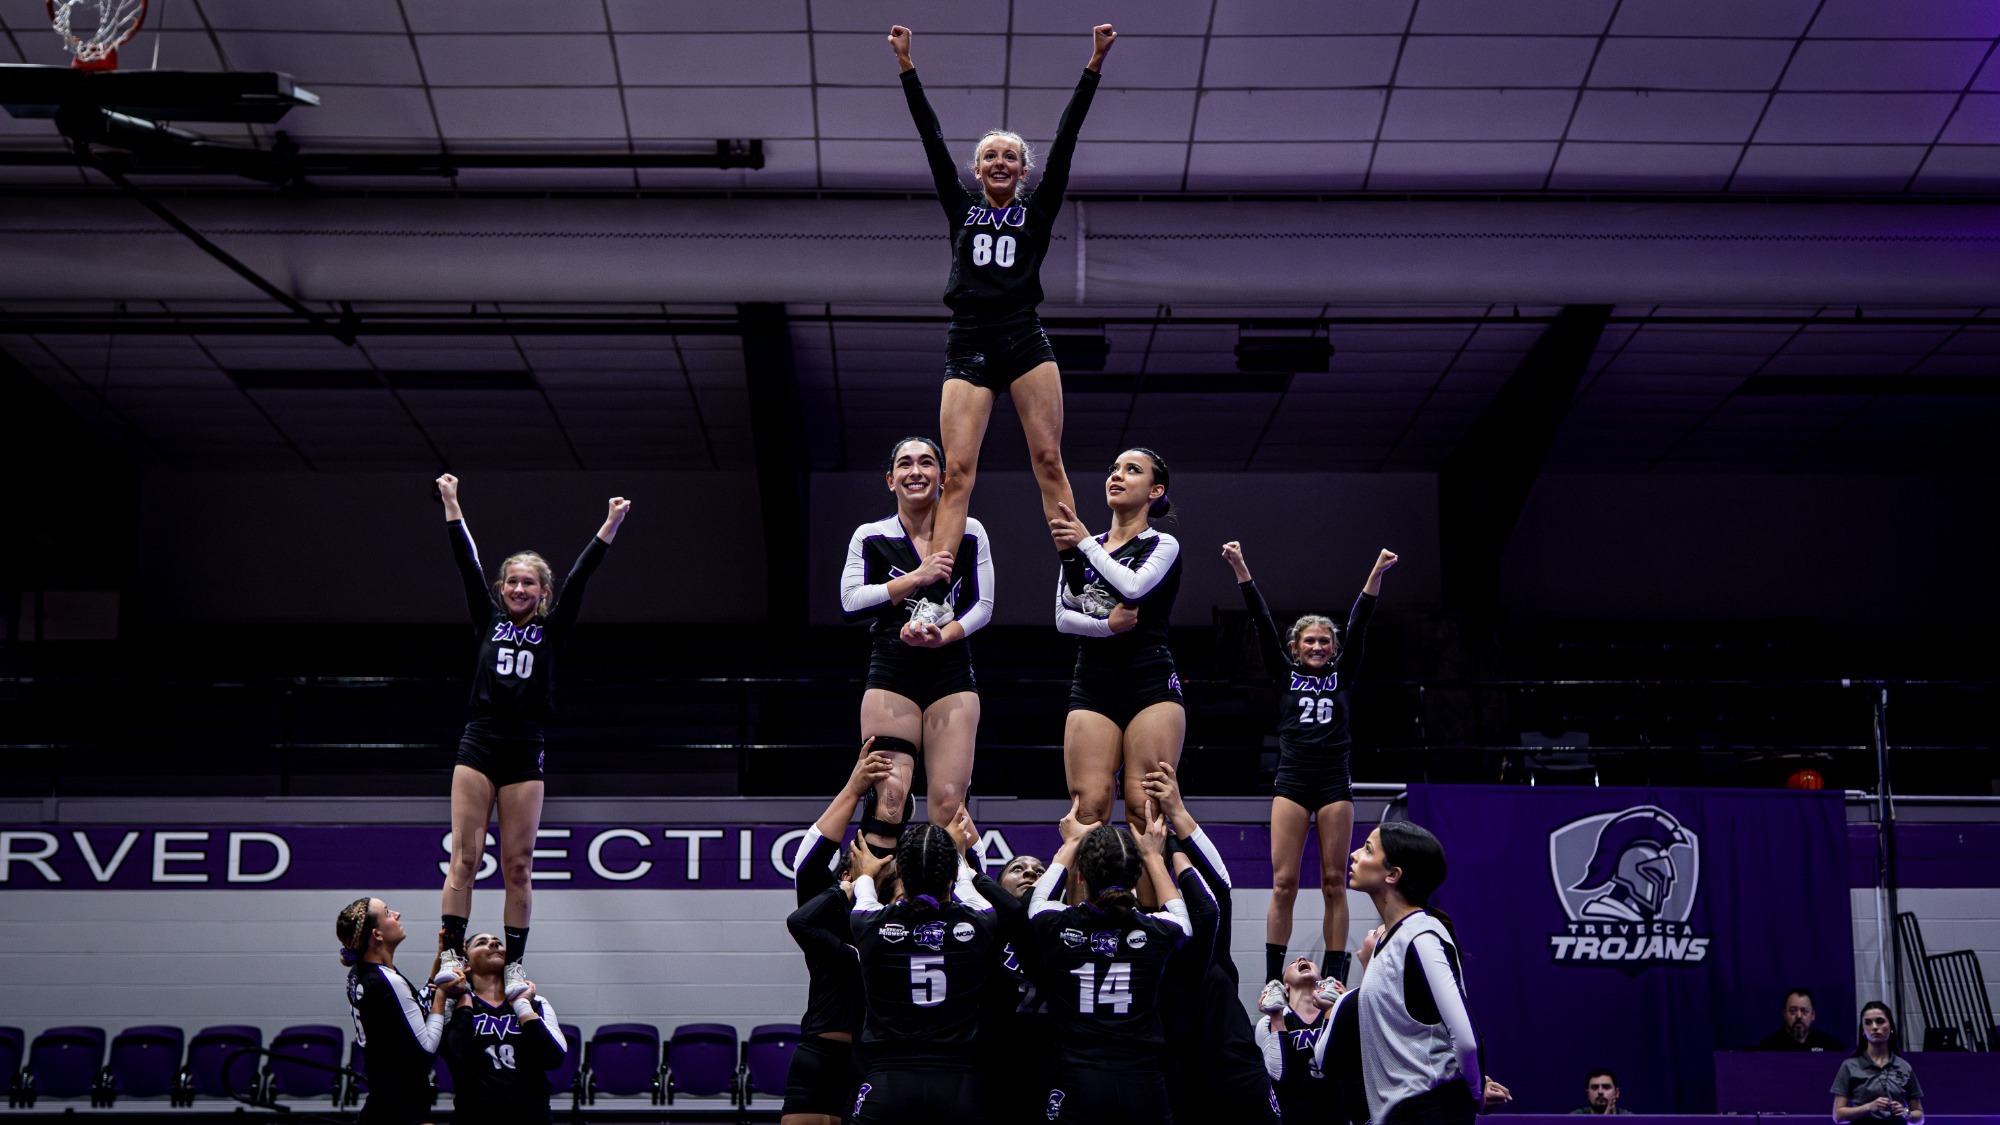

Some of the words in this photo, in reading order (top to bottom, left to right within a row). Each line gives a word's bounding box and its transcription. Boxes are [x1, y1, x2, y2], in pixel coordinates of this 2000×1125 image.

[973, 233, 1017, 268] 80
[496, 647, 534, 679] 50
[1290, 670, 1338, 696] TNU
[1298, 696, 1334, 724] 26
[0, 831, 291, 882] RVED
[438, 829, 842, 882] SECTI
[1568, 923, 1693, 936] TREVECCA
[1551, 935, 1710, 961] TROJANS
[911, 955, 947, 1007] 5
[1070, 962, 1132, 1013] 14
[350, 1004, 367, 1048] 5
[1289, 1027, 1325, 1051] TN
[485, 1044, 516, 1070] 18
